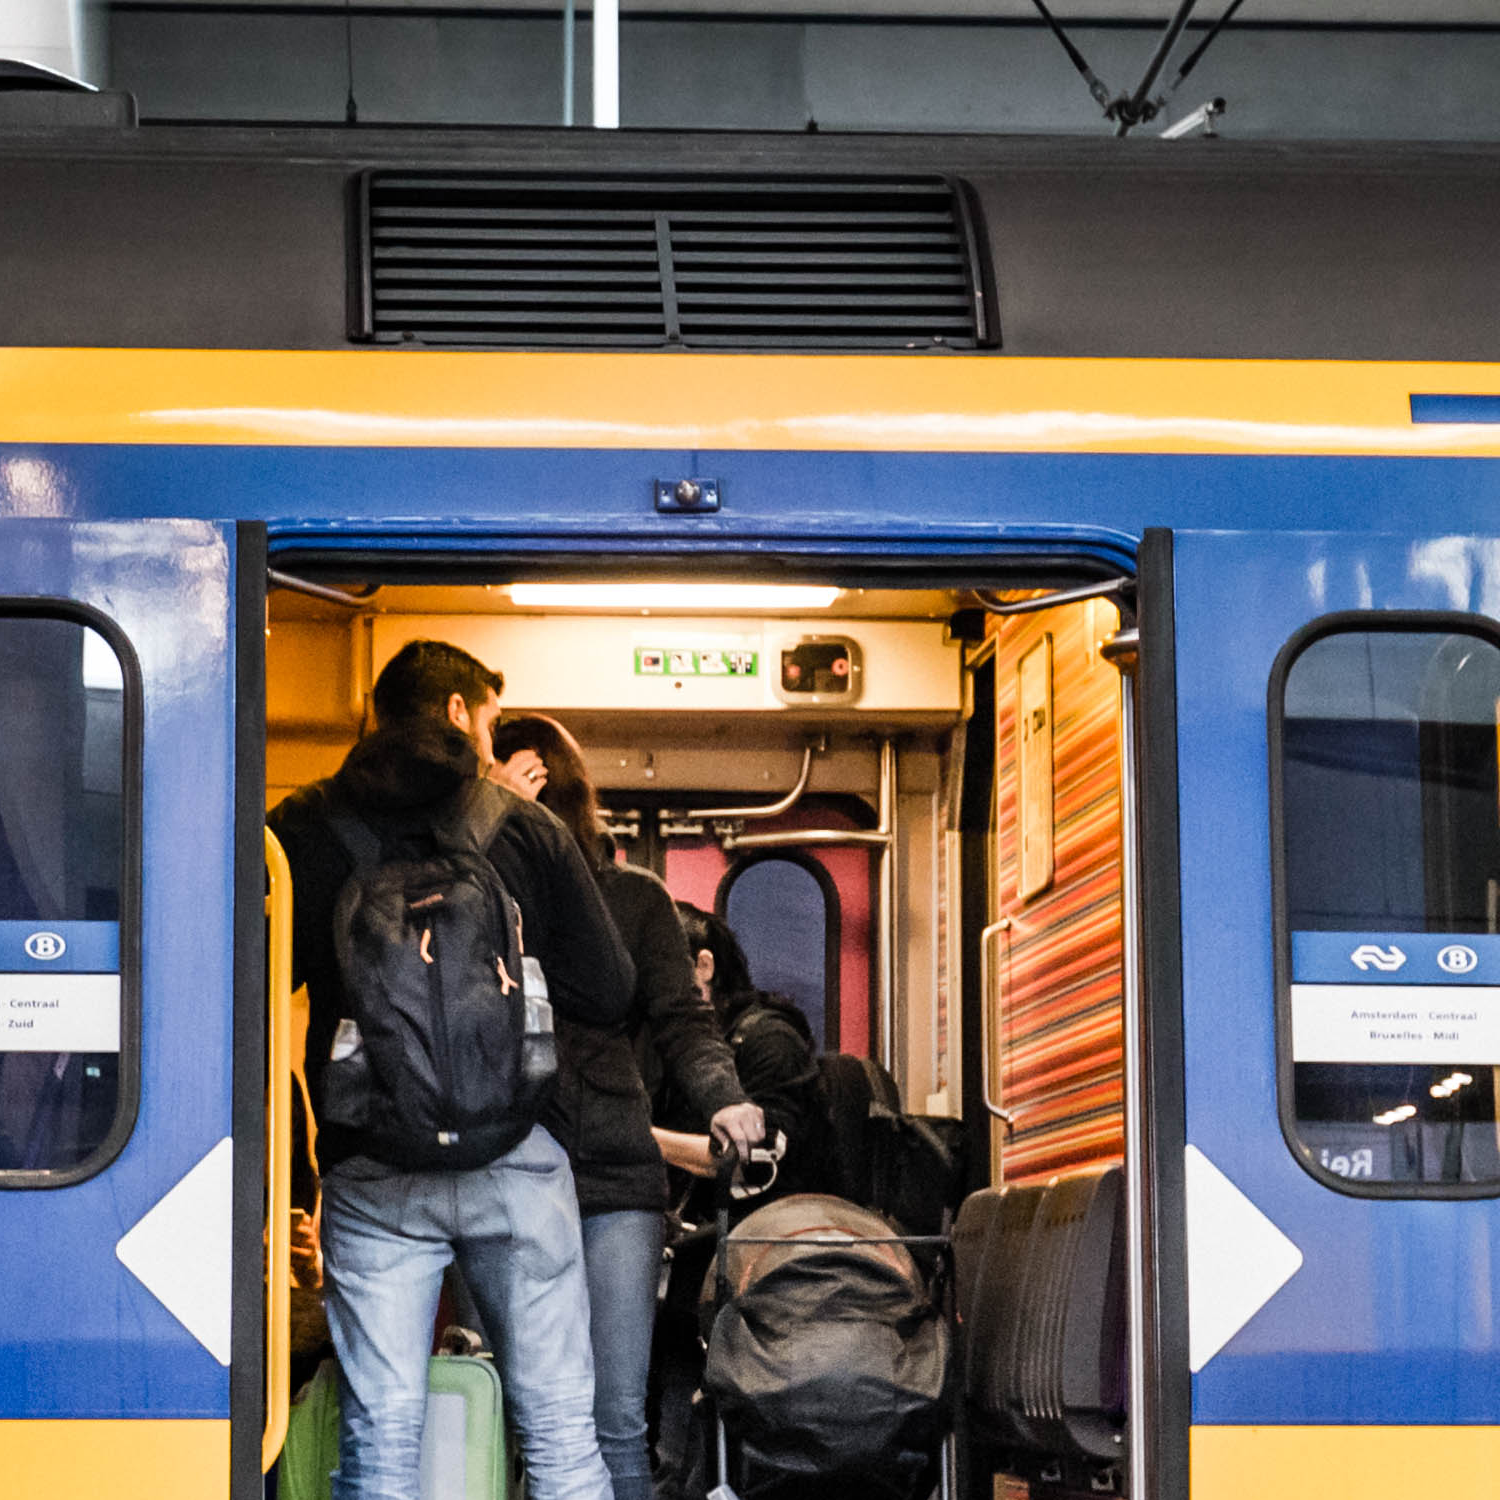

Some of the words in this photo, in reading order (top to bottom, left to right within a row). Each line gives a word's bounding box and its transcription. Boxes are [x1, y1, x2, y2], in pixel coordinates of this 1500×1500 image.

[9, 998, 60, 1008] Centraal
[1350, 1010, 1418, 1020] Amsterdam
[1428, 1010, 1477, 1020] Centraal
[8, 1019, 34, 1028] Zuid
[1369, 1031, 1423, 1040] Bruxelles
[1433, 1031, 1459, 1040] Midi
